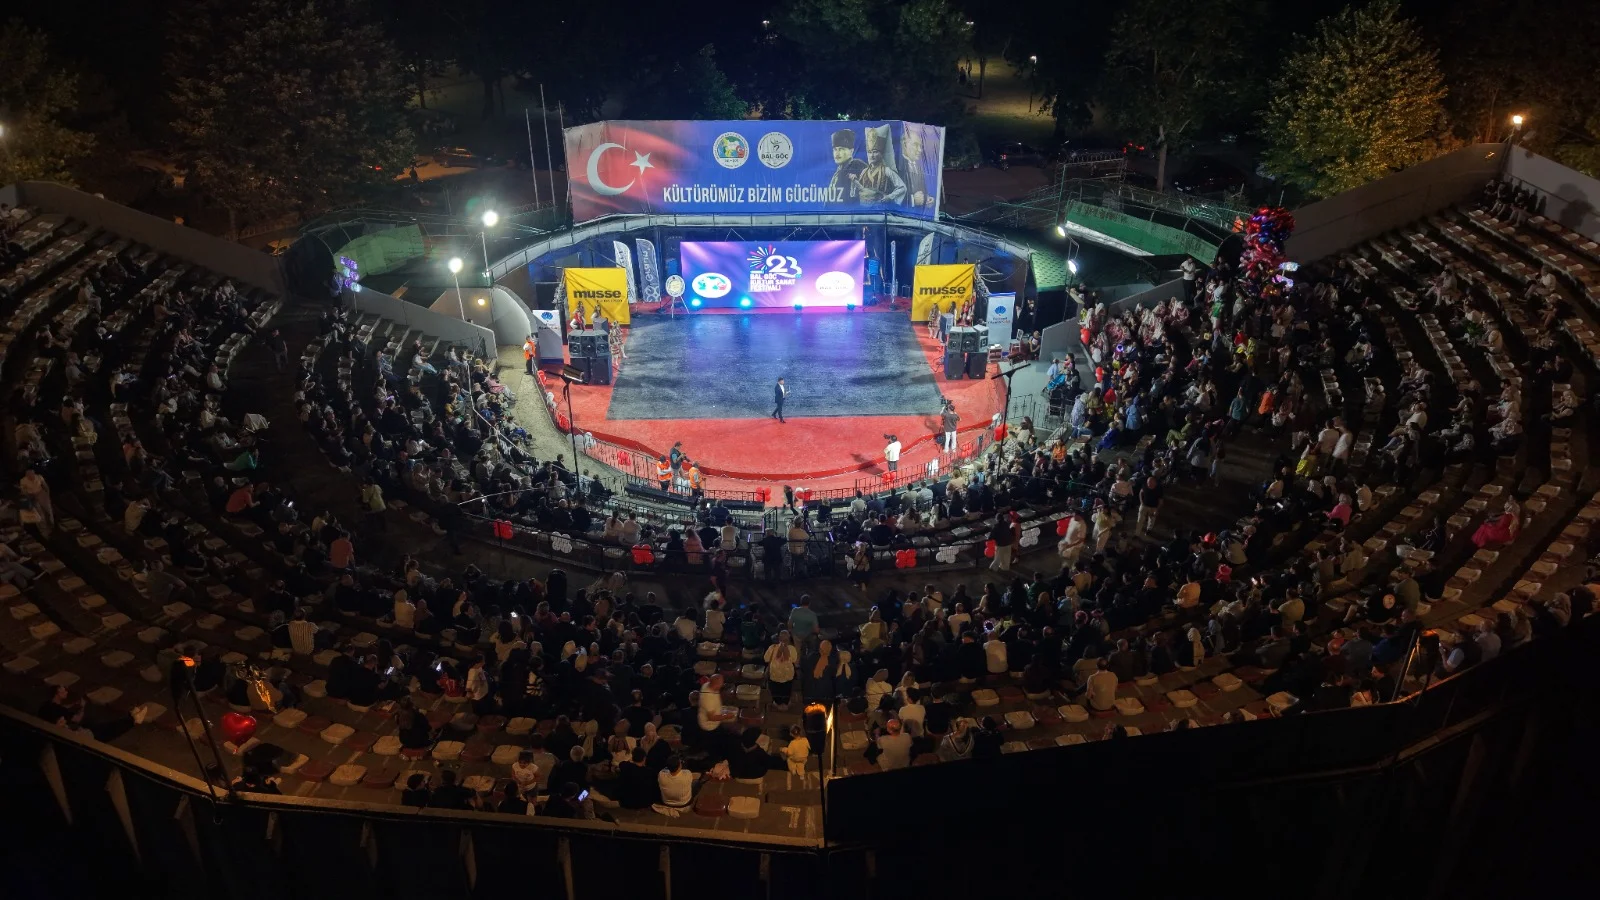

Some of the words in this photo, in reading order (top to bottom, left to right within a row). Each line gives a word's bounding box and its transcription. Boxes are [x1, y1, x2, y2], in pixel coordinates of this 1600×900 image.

[663, 185, 744, 203] KÜLTÜRÜMÜZ
[748, 185, 782, 203] BİZİM
[785, 184, 844, 203] GÜCÜMÜZ
[573, 290, 622, 299] musse
[919, 286, 967, 295] musse
